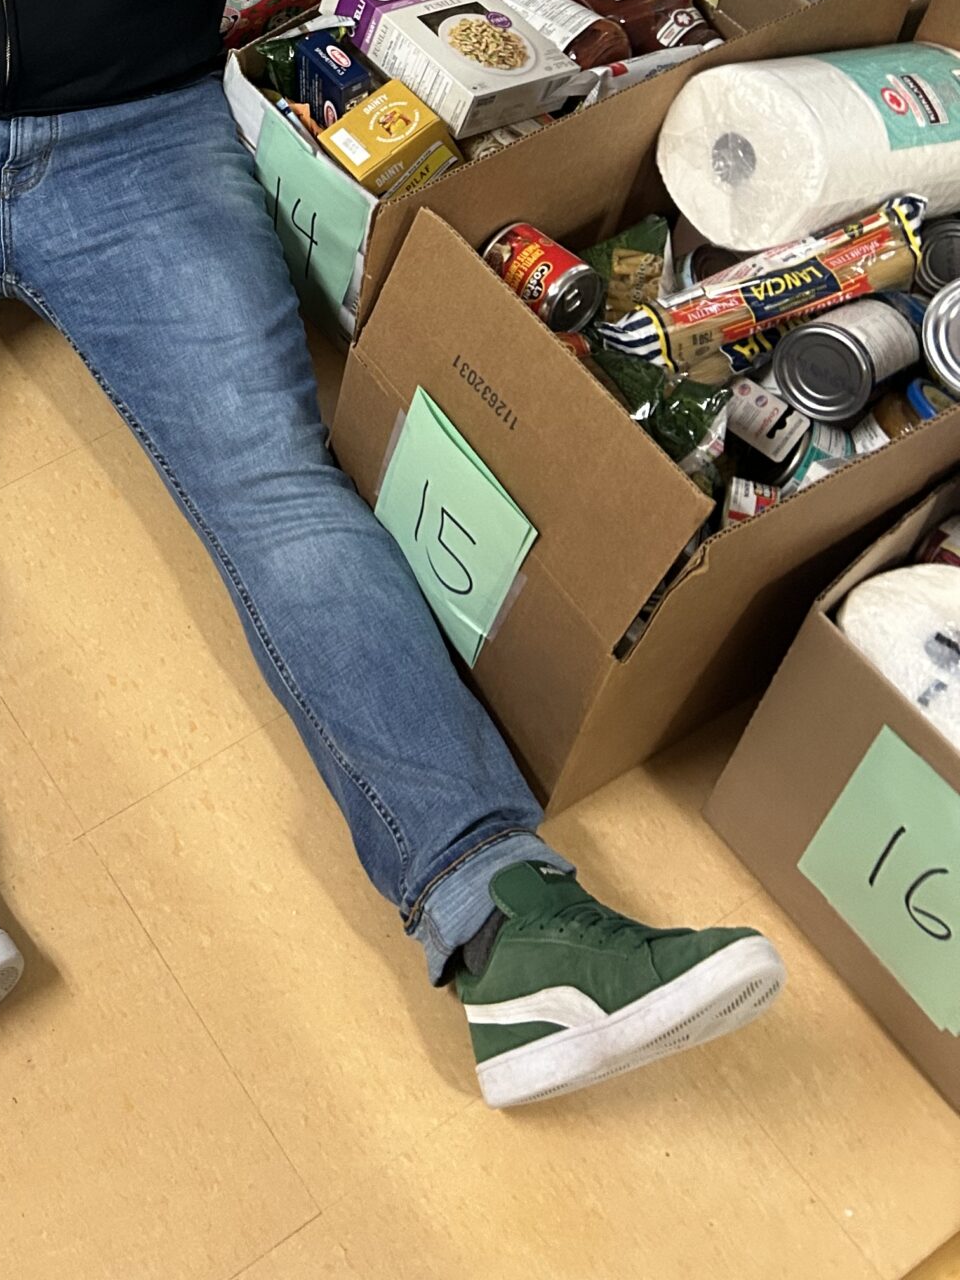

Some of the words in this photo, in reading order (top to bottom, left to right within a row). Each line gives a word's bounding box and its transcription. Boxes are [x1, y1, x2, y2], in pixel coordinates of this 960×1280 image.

[372, 24, 389, 61] FUSILLI
[362, 93, 389, 116] DAINTY
[375, 160, 405, 188] DAINTY
[405, 164, 432, 193] PILAF
[274, 176, 319, 280] 14
[828, 239, 880, 267] SPAGHETTINI
[522, 263, 550, 301] Coste
[531, 283, 543, 300] La
[749, 264, 825, 300] LANCIA
[699, 330, 713, 344] 750
[451, 354, 519, 432] 112632031
[413, 479, 478, 596] 15
[868, 825, 953, 941] 16
